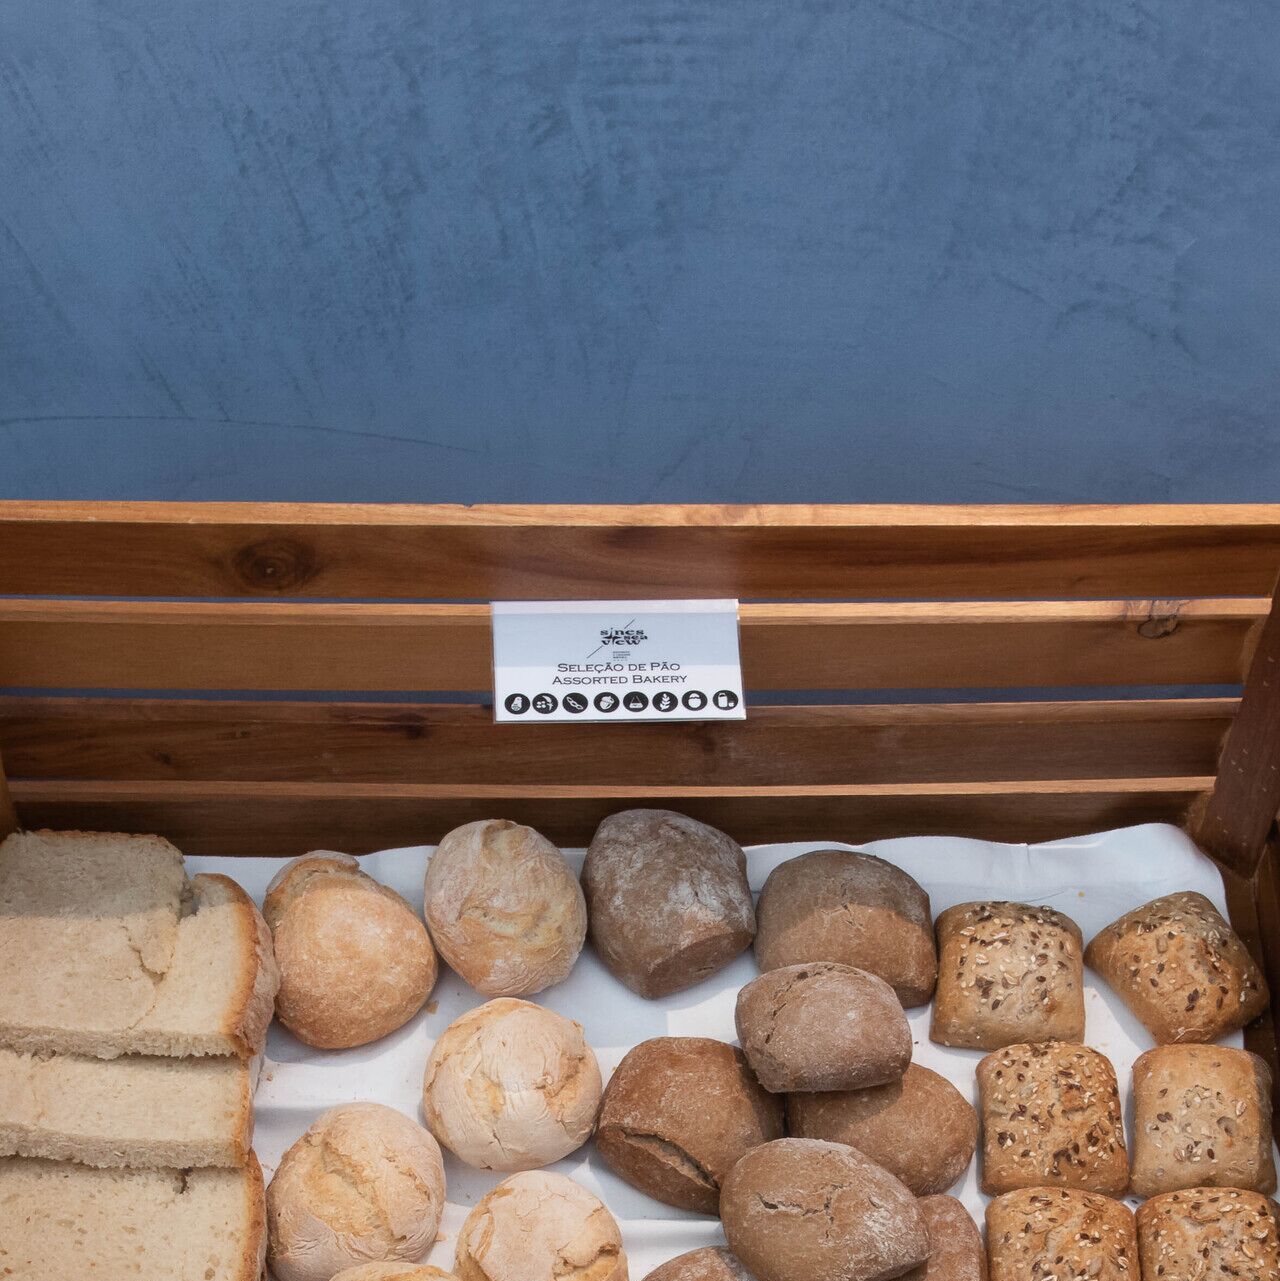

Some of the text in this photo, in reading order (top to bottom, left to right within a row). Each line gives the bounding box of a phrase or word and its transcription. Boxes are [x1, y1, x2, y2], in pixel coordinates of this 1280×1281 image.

[557, 661, 681, 674] SELEÇÃO DE PÃO
[551, 674, 688, 686] ASSORTED BAKERY
